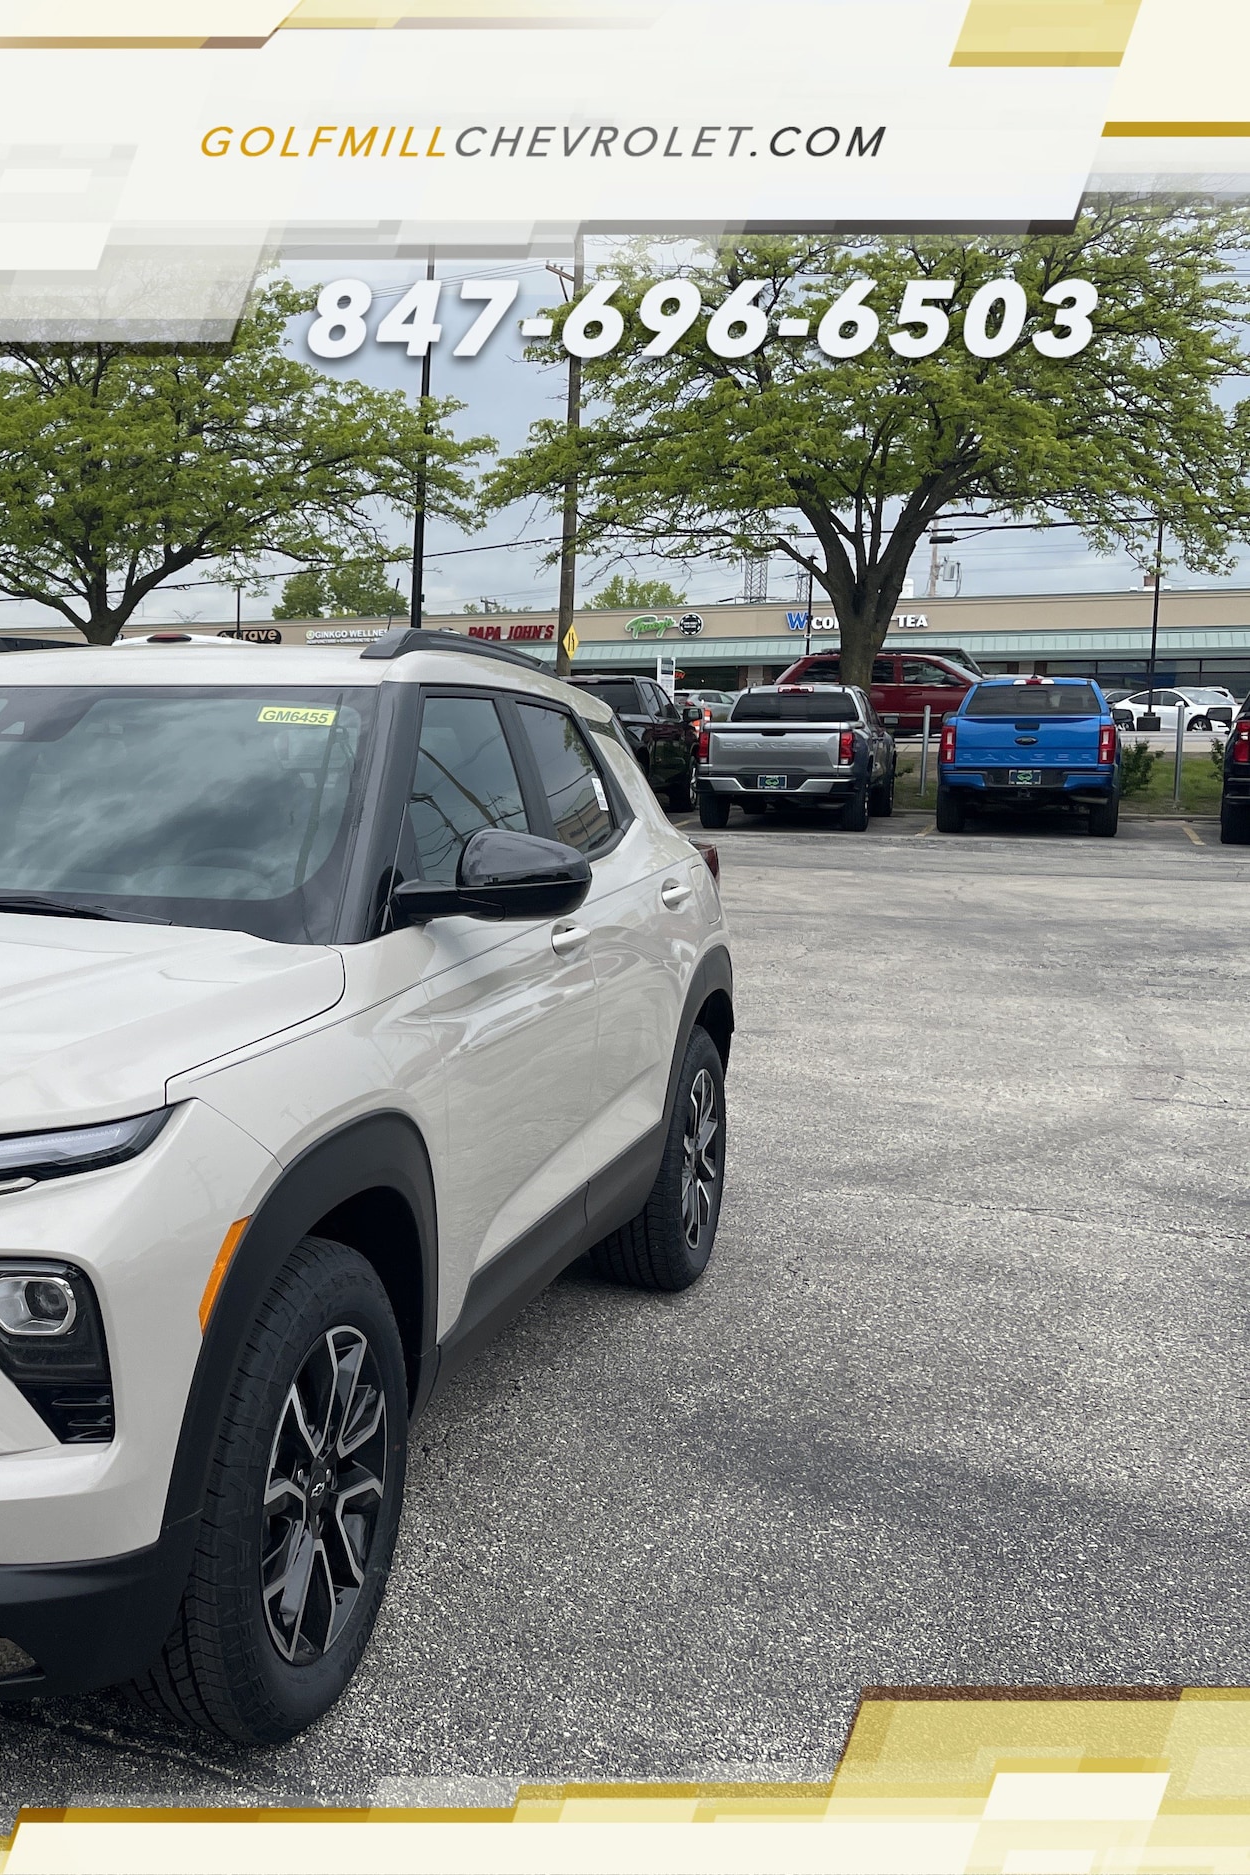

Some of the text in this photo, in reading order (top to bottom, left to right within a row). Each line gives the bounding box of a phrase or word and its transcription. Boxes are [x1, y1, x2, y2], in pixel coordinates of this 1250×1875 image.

[897, 614, 928, 628] TEA
[314, 630, 348, 639] GINKGO
[468, 624, 555, 641] PAPA JOHN'S
[263, 710, 329, 724] GM6455
